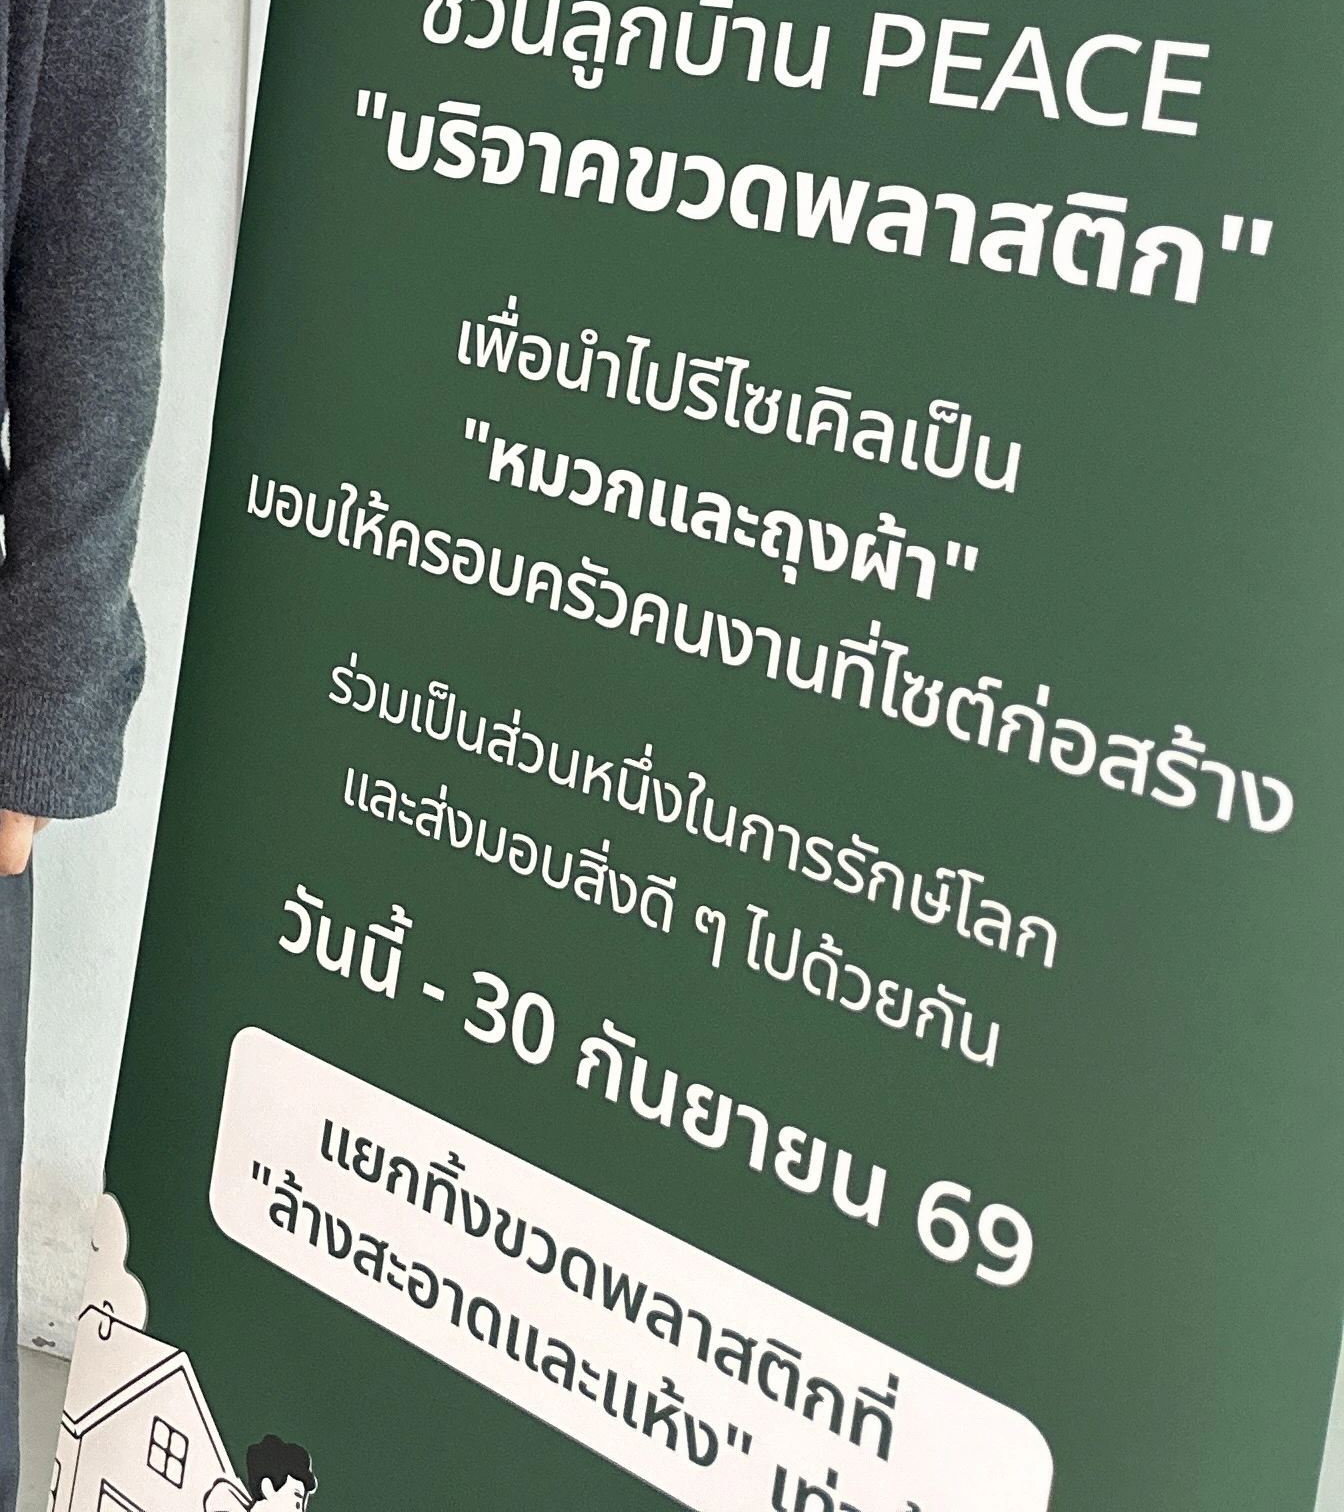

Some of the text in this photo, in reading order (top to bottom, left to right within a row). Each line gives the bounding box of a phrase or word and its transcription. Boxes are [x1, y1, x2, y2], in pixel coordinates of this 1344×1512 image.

[357, 90, 1273, 302] "บริจาคขวดพลาสติก"
[863, 13, 1209, 135] PEACE
[458, 295, 1021, 493] เพื่อนำไปรีไซเคิลเป็น
[465, 418, 978, 600] "หมวกและถุงผ้า"
[248, 474, 1293, 832] มอบให้ครอบครัวคนงานที่ไซต์ก่อสร้าง
[329, 652, 1056, 968] ร่วมเป็นส่วนหนึ่งในการรักษ์โลก
[345, 768, 999, 1067] และส่งมอบสิ่งดี ๆ ไปด้วยกัน
[279, 884, 1032, 1285] วันนี้ - 30 กันยายน 69
[252, 1161, 752, 1466] "ล้างสะอาดและแห้ง"
[321, 1119, 899, 1461] แยกทิ้งขวดพลาสติกที่
